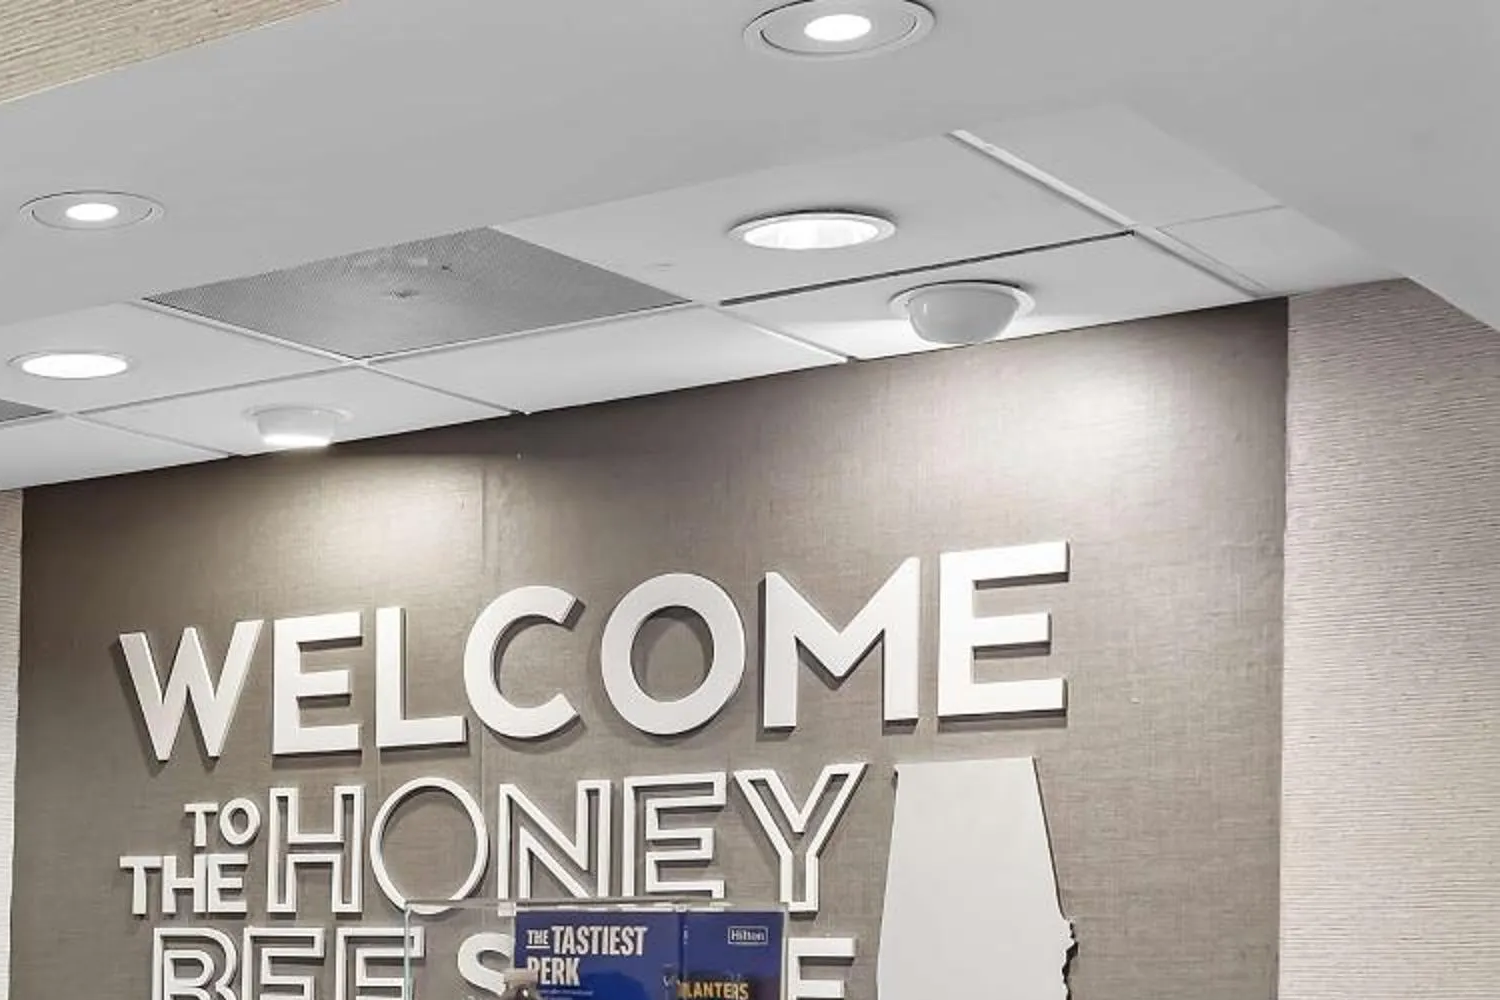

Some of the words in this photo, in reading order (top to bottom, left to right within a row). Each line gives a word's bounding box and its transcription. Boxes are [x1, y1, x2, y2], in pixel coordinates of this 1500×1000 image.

[119, 540, 1070, 760] WELCOME
[184, 798, 261, 847] TO
[267, 762, 868, 915] HONEY
[119, 853, 249, 915] THE
[526, 929, 549, 946] THE
[551, 924, 648, 956] TASTIEST
[730, 928, 766, 942] Hilton
